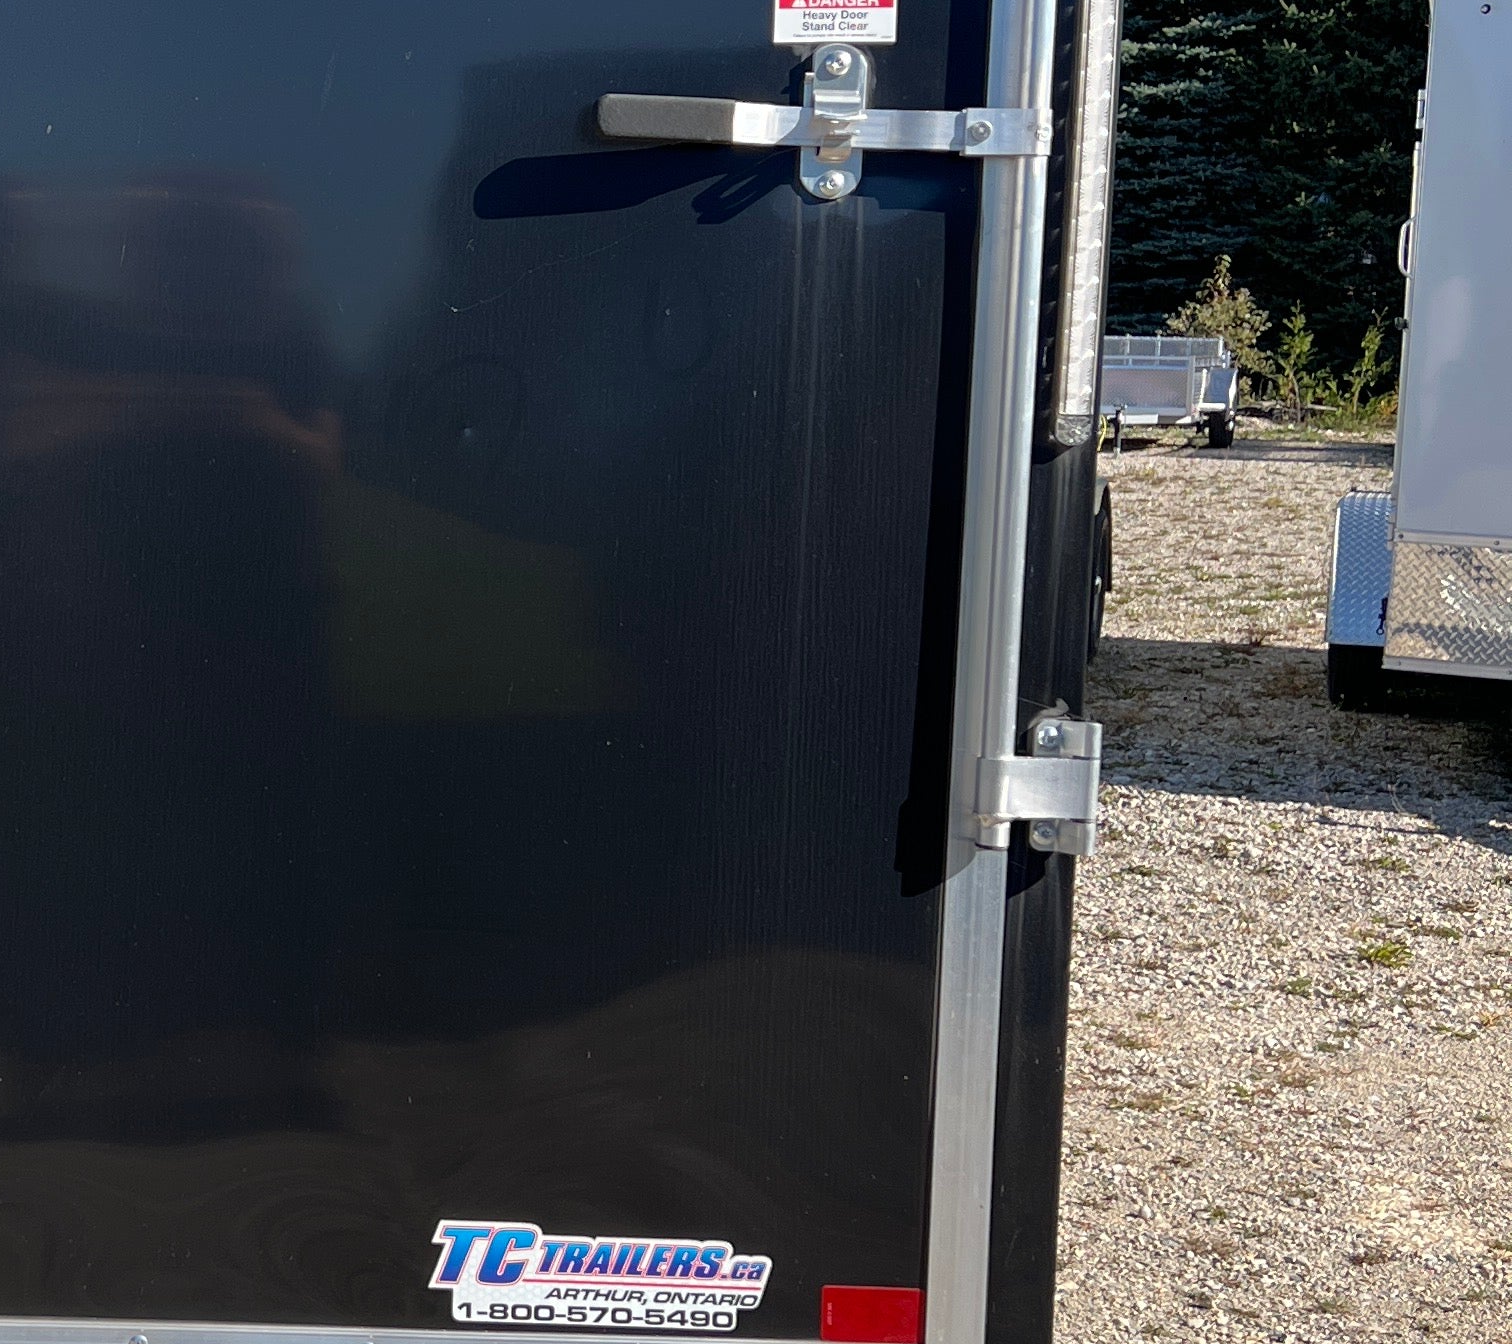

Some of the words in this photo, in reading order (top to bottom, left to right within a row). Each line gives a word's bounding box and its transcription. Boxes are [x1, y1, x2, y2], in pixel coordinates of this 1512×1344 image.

[802, 10, 837, 21] Heavy
[840, 9, 869, 20] Door
[802, 21, 835, 31] Stand
[838, 21, 869, 31] Clear
[437, 1226, 538, 1286] TC
[536, 1240, 767, 1282] TRAILERS.ca
[544, 1288, 648, 1306] ARTHUR,
[653, 1291, 759, 1307] ONTARIO
[457, 1302, 734, 1328] 1-800-570-5490
